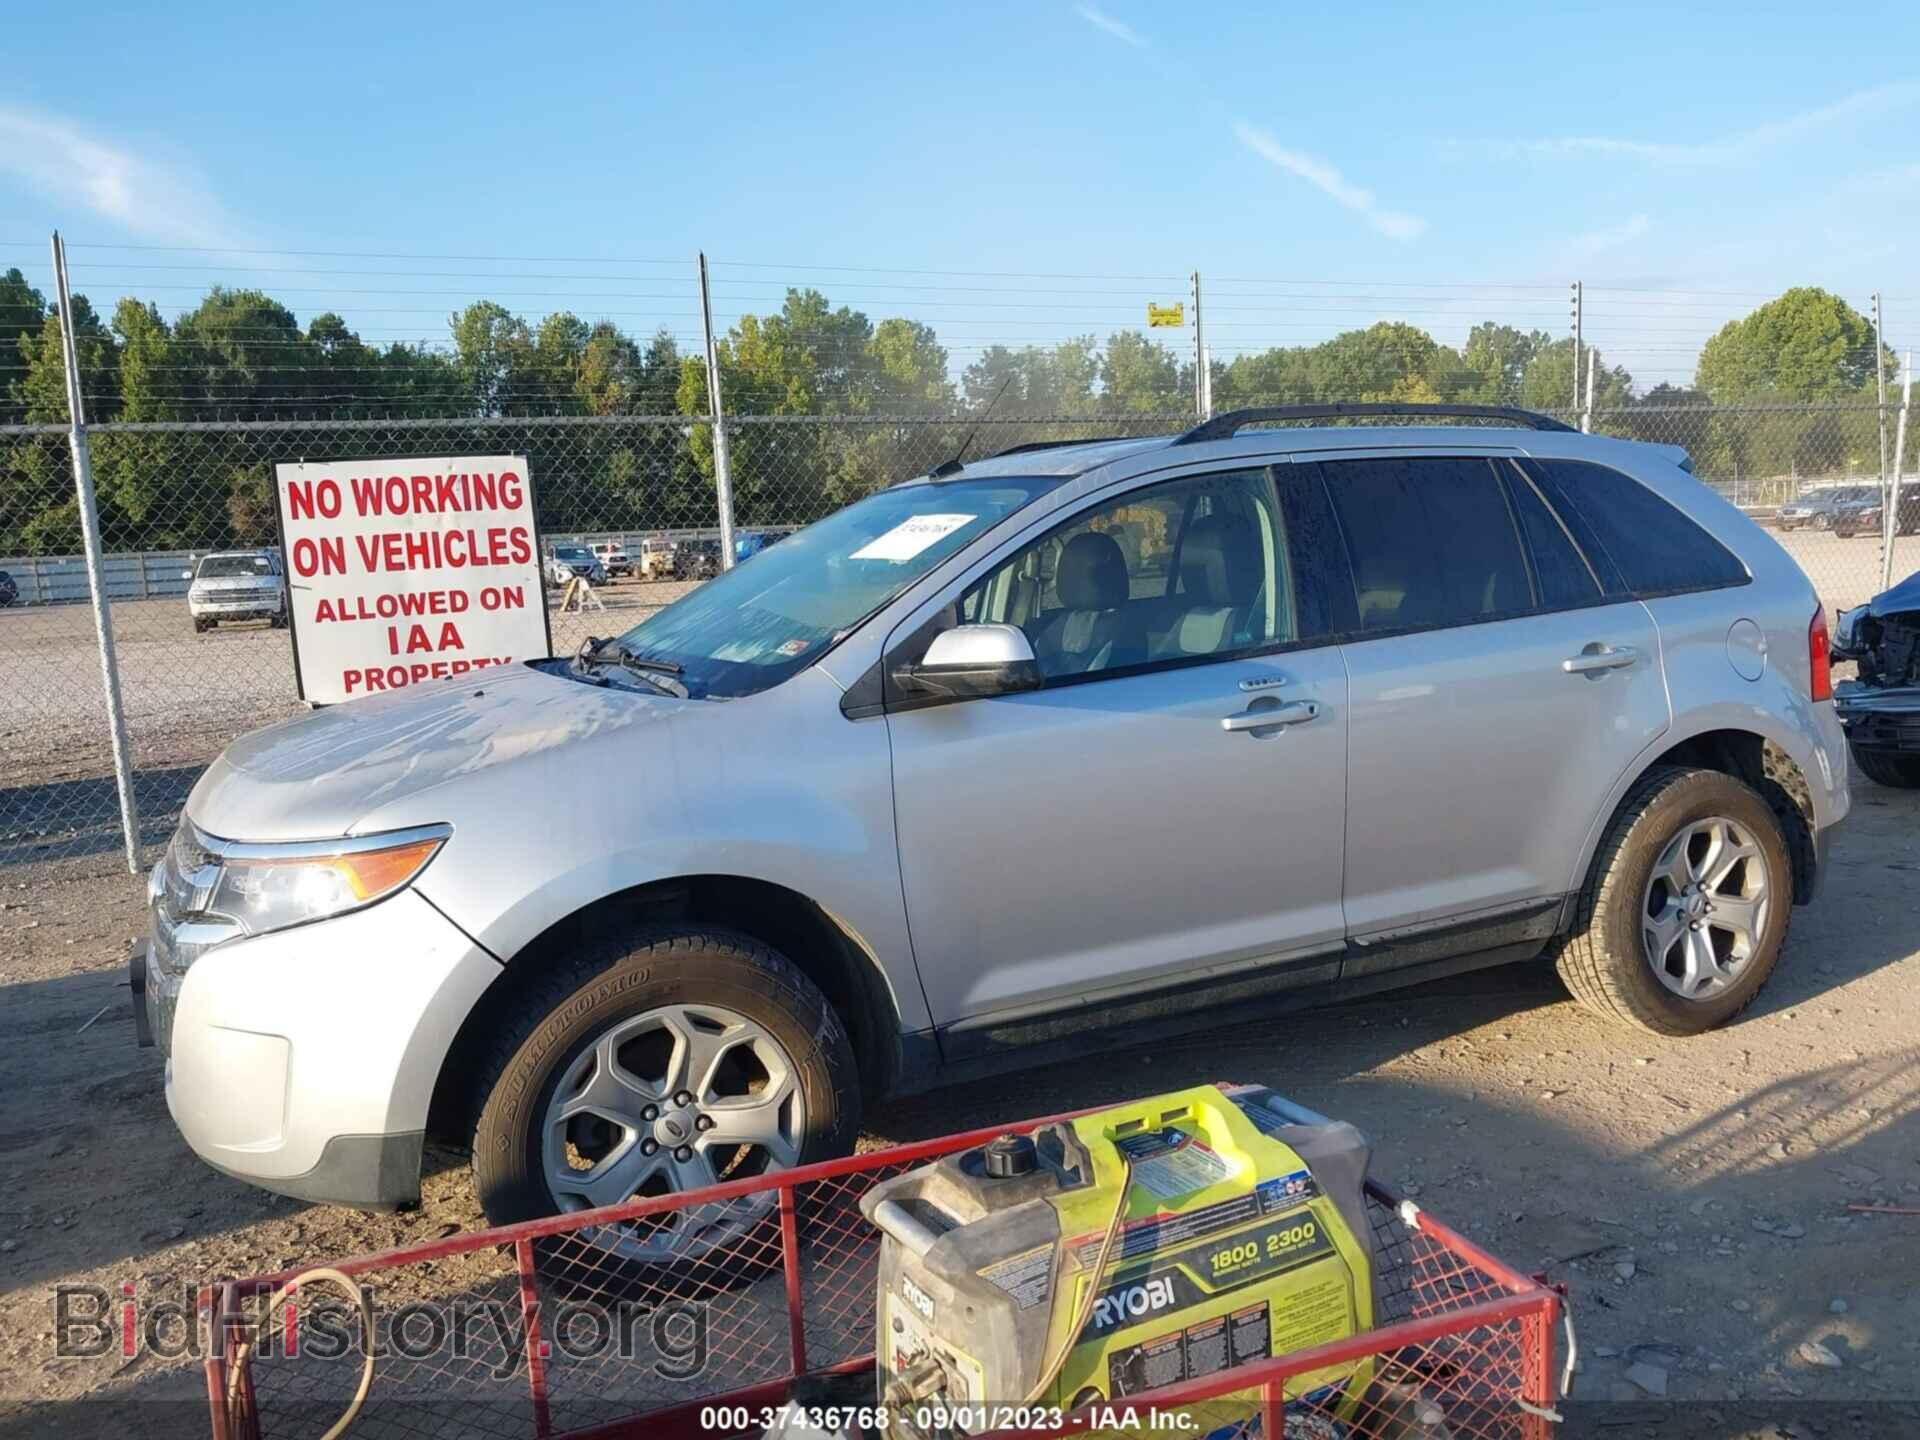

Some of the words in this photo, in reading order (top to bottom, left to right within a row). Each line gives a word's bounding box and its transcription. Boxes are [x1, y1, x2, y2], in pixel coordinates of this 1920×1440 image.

[287, 478, 343, 521] NO
[350, 471, 523, 517] WORKING
[293, 537, 347, 578] ON
[355, 526, 532, 573] VEHICLES
[315, 589, 469, 623] ALLOWED
[480, 585, 525, 611] ON
[388, 621, 465, 656] IAA
[502, 967, 651, 1121] SUMITOMO
[1210, 1241, 1258, 1271] 1800
[1266, 1222, 1316, 1252] 2300
[1092, 1276, 1176, 1329] RYOBI
